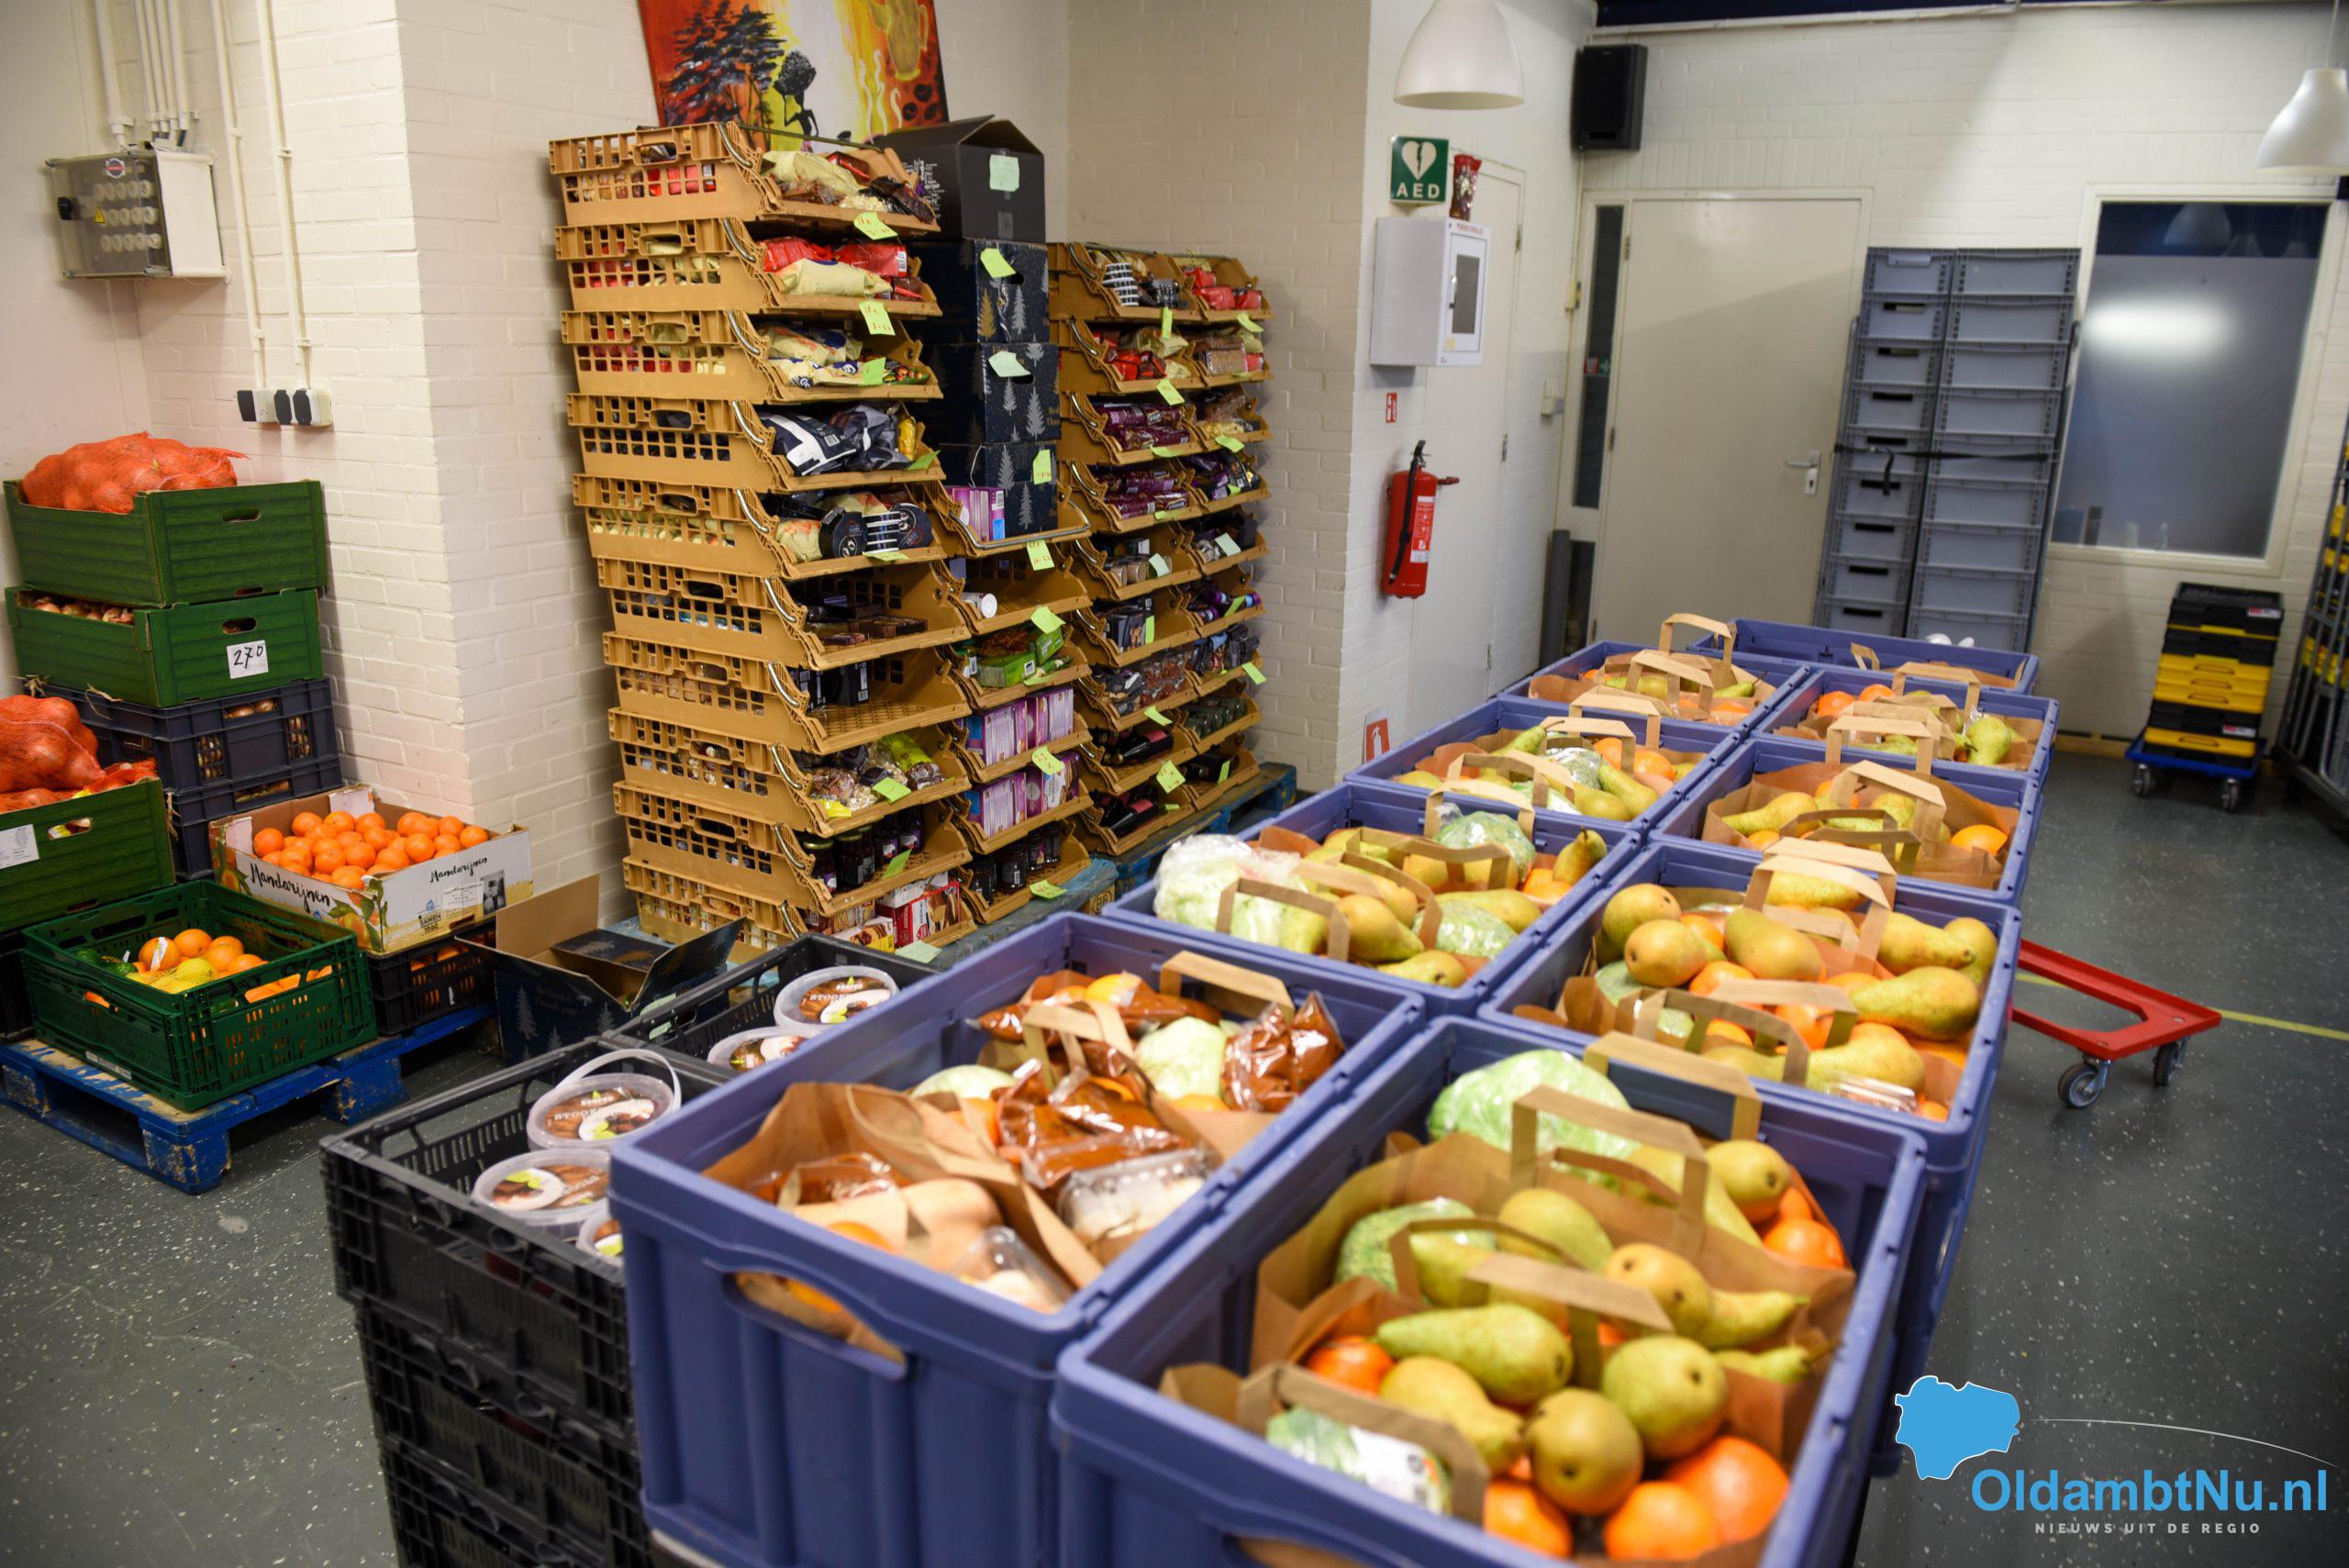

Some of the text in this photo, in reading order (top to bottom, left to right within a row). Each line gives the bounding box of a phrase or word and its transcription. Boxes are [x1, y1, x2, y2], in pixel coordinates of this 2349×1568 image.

[1397, 183, 1441, 199] AED
[234, 645, 264, 670] 270
[429, 857, 488, 883] Mandarijnen
[250, 862, 330, 915] Mandarijnen
